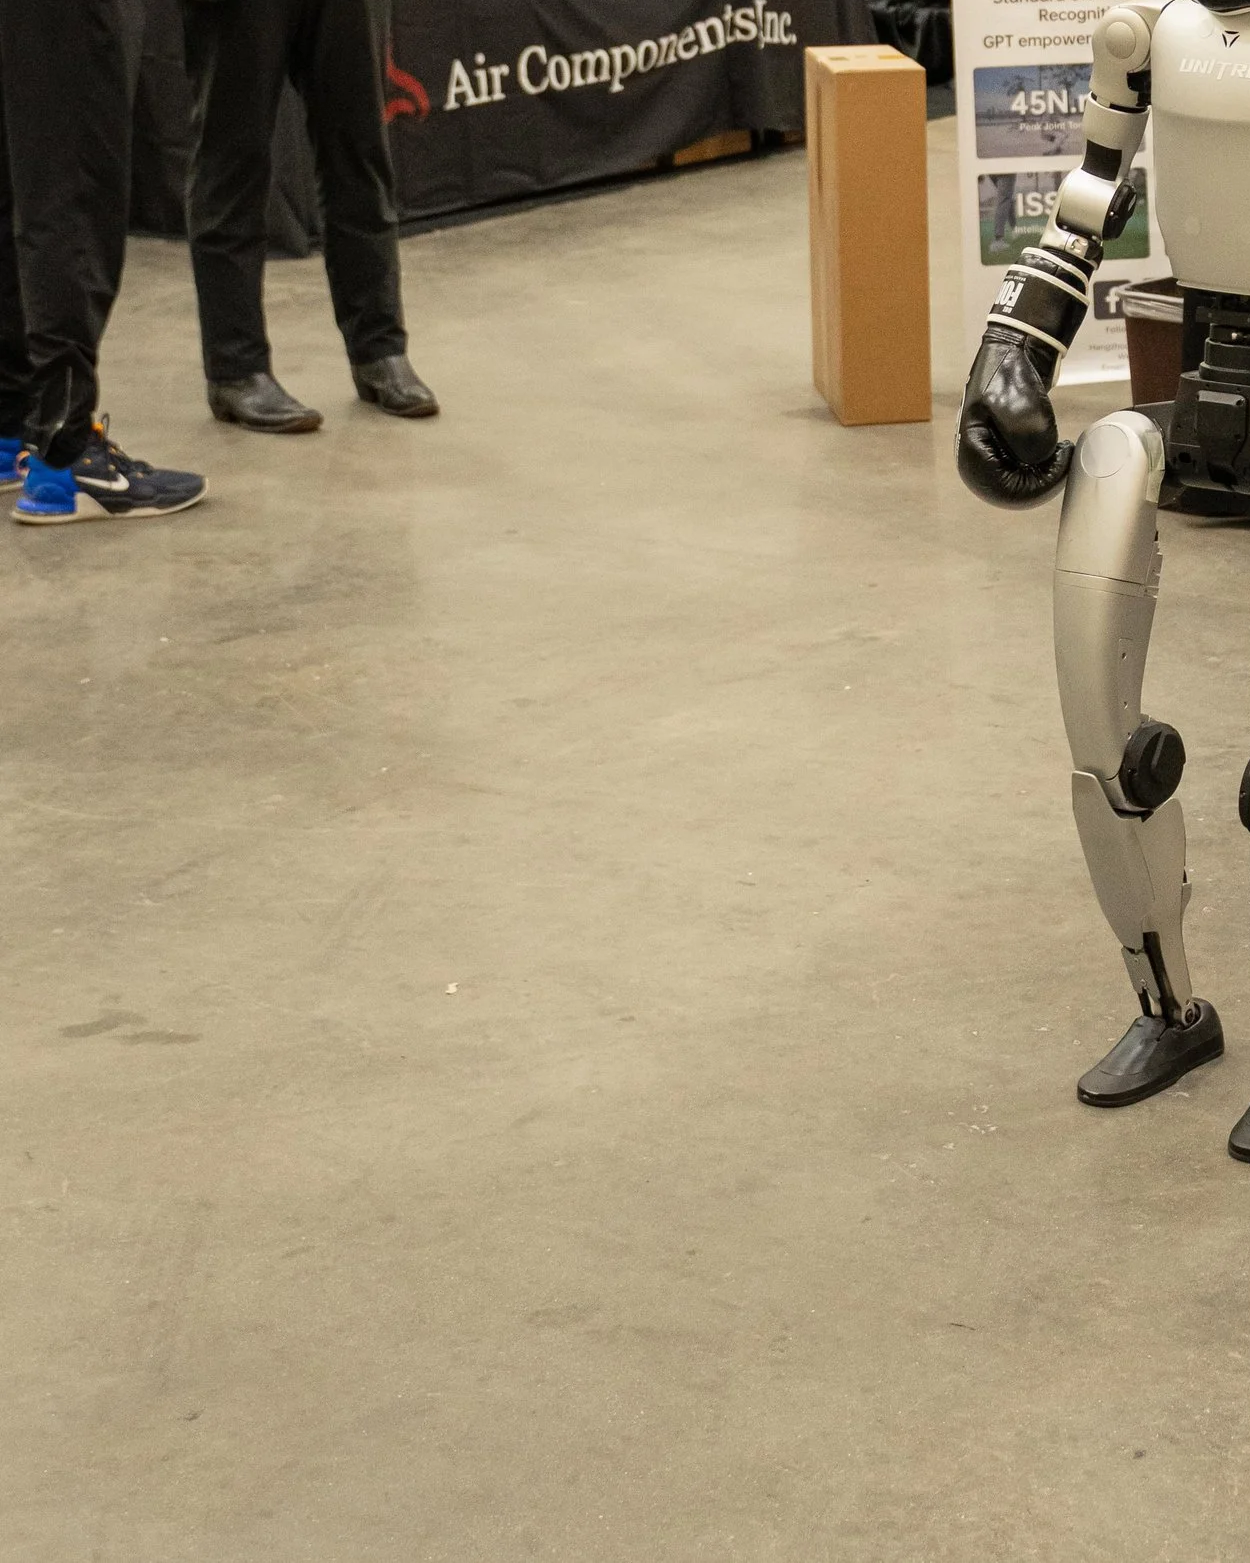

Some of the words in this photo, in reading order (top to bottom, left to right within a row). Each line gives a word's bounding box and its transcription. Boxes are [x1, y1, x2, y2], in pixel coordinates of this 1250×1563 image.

[983, 34, 1014, 49] GPT
[443, 53, 509, 111] Air
[1019, 122, 1042, 132] Peak
[1044, 121, 1066, 132] Joint
